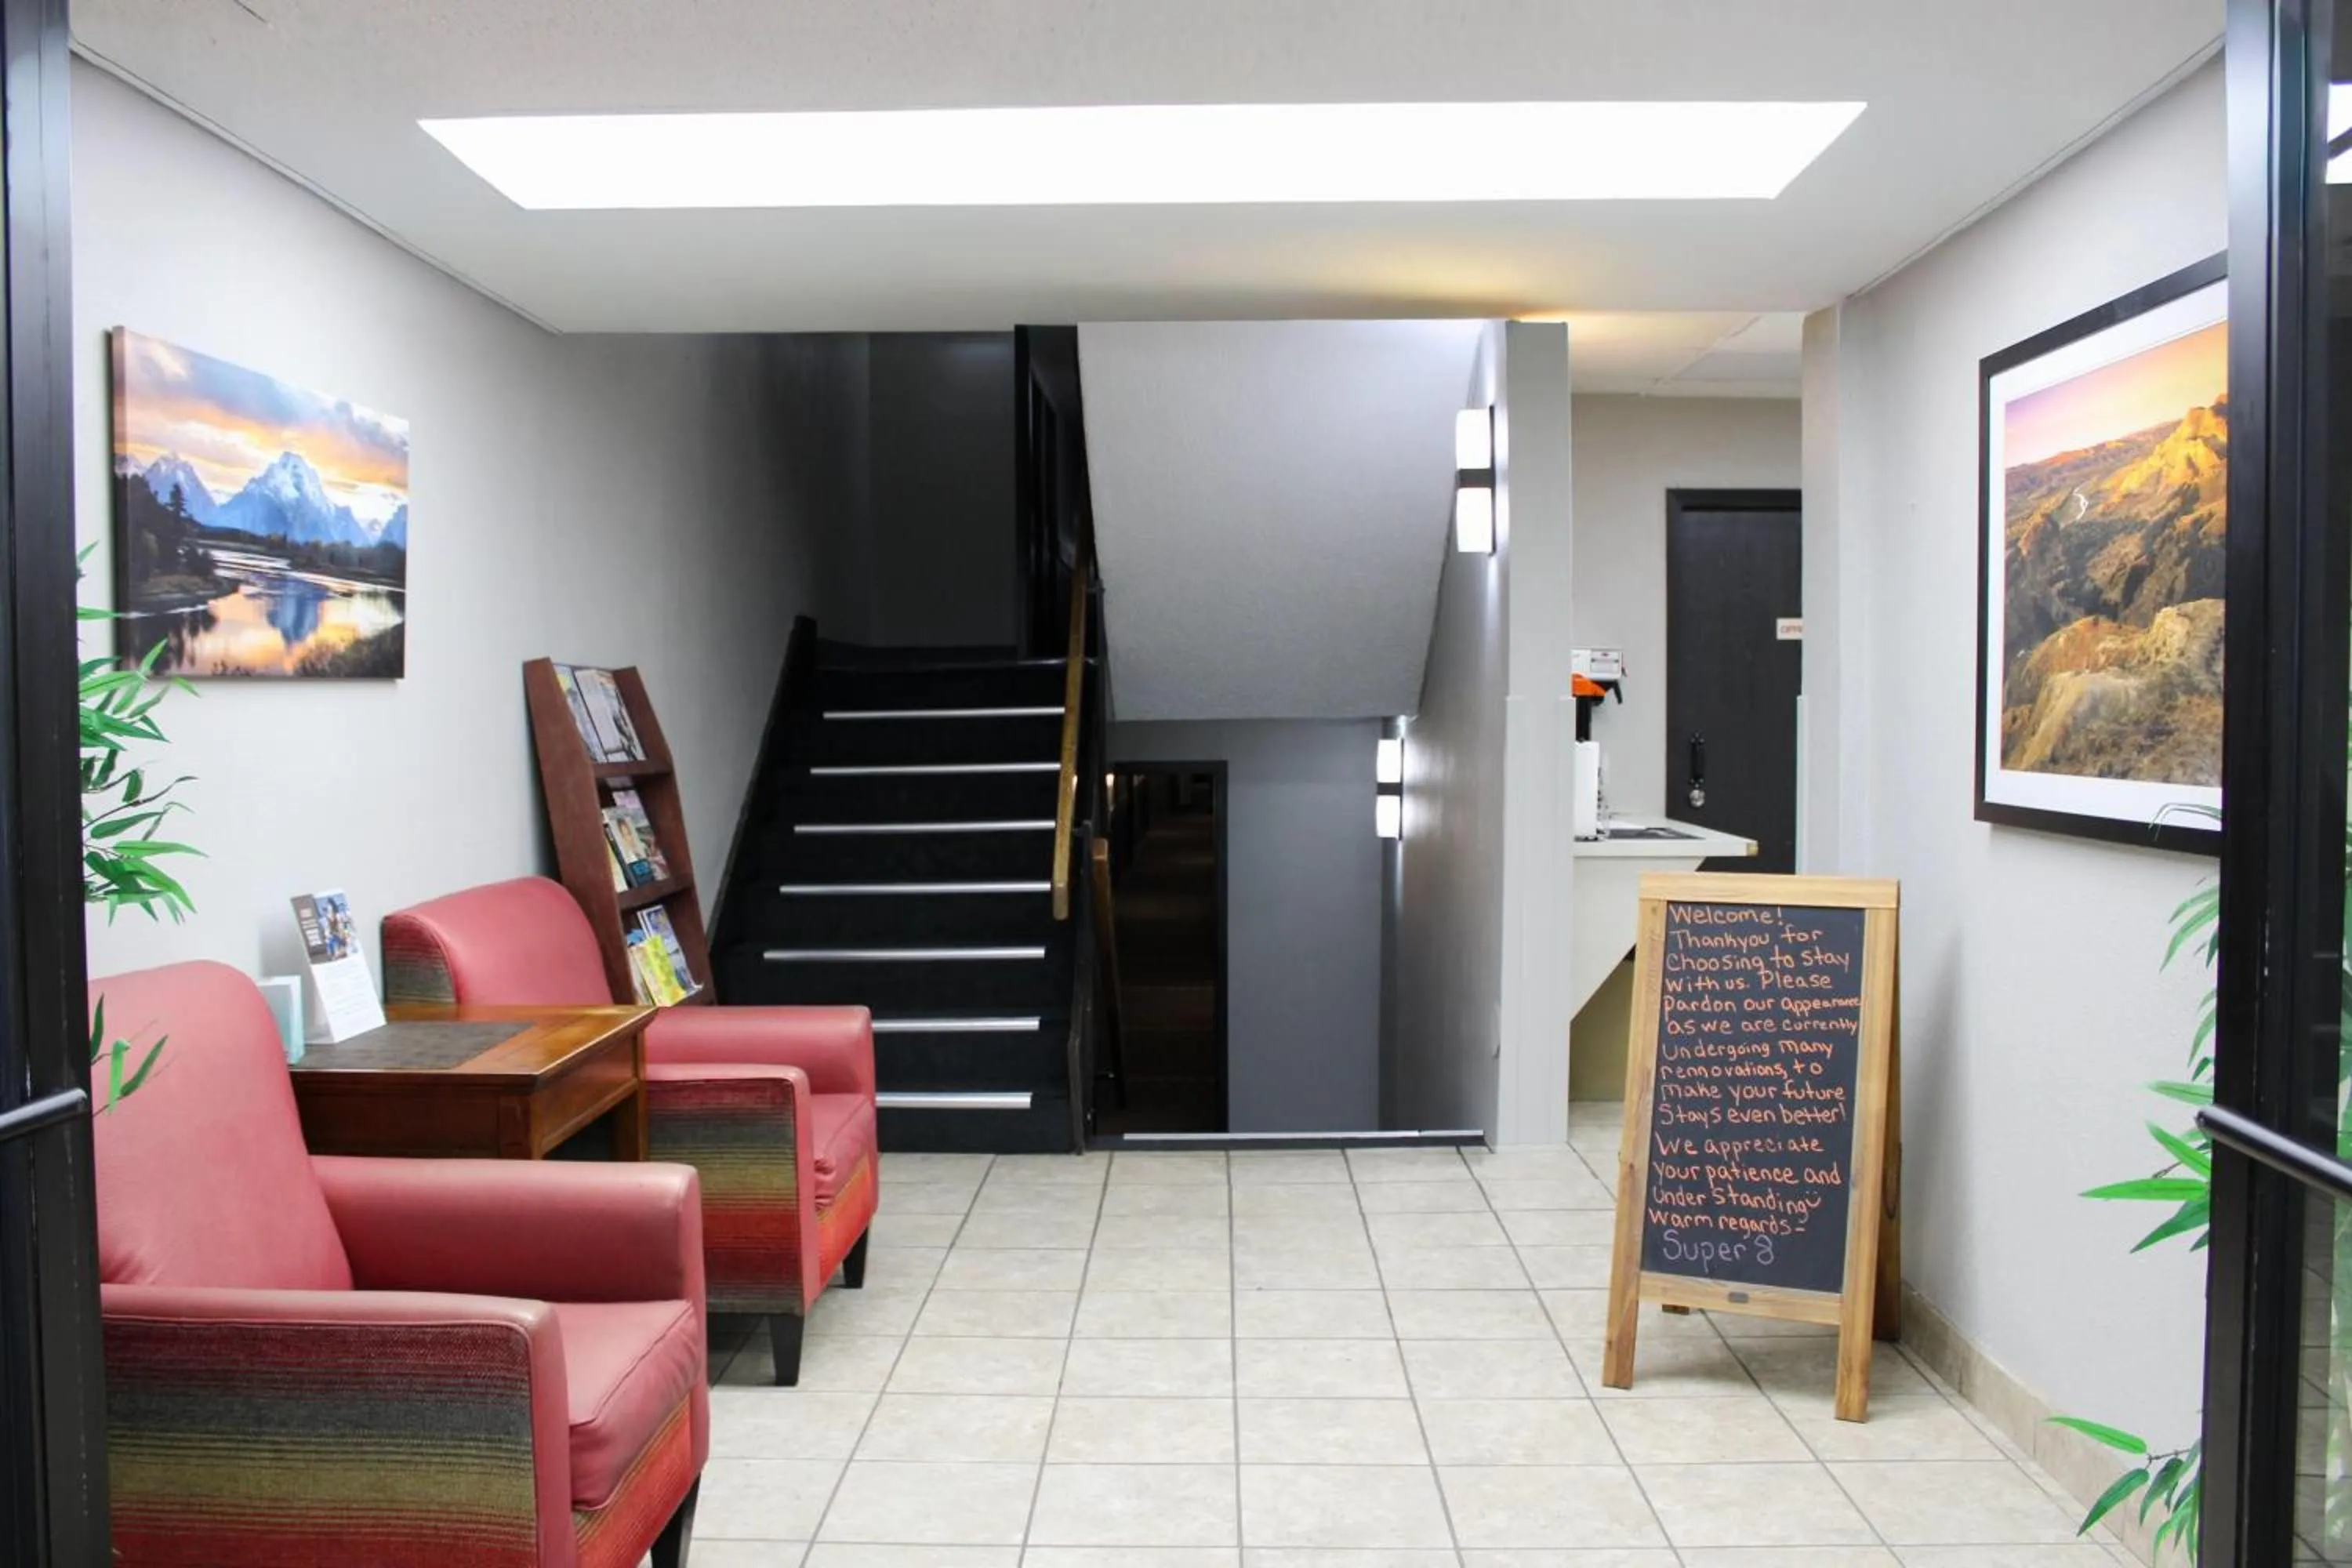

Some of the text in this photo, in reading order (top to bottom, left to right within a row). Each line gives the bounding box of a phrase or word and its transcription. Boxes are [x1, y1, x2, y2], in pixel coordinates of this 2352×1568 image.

[1780, 924, 1823, 942] for
[1769, 944, 1795, 969] to
[1758, 970, 1833, 990] Please
[1700, 1018, 1732, 1034] we
[1741, 1018, 1777, 1034] are
[1793, 1058, 1824, 1076] to
[1728, 1083, 1777, 1106] your
[1782, 1079, 1846, 1101] future
[1727, 1108, 1777, 1124] even
[1654, 1131, 1698, 1156] We
[1706, 1162, 1798, 1189] patience
[1804, 1161, 1842, 1185] and
[1663, 1229, 1774, 1274] Super 8
